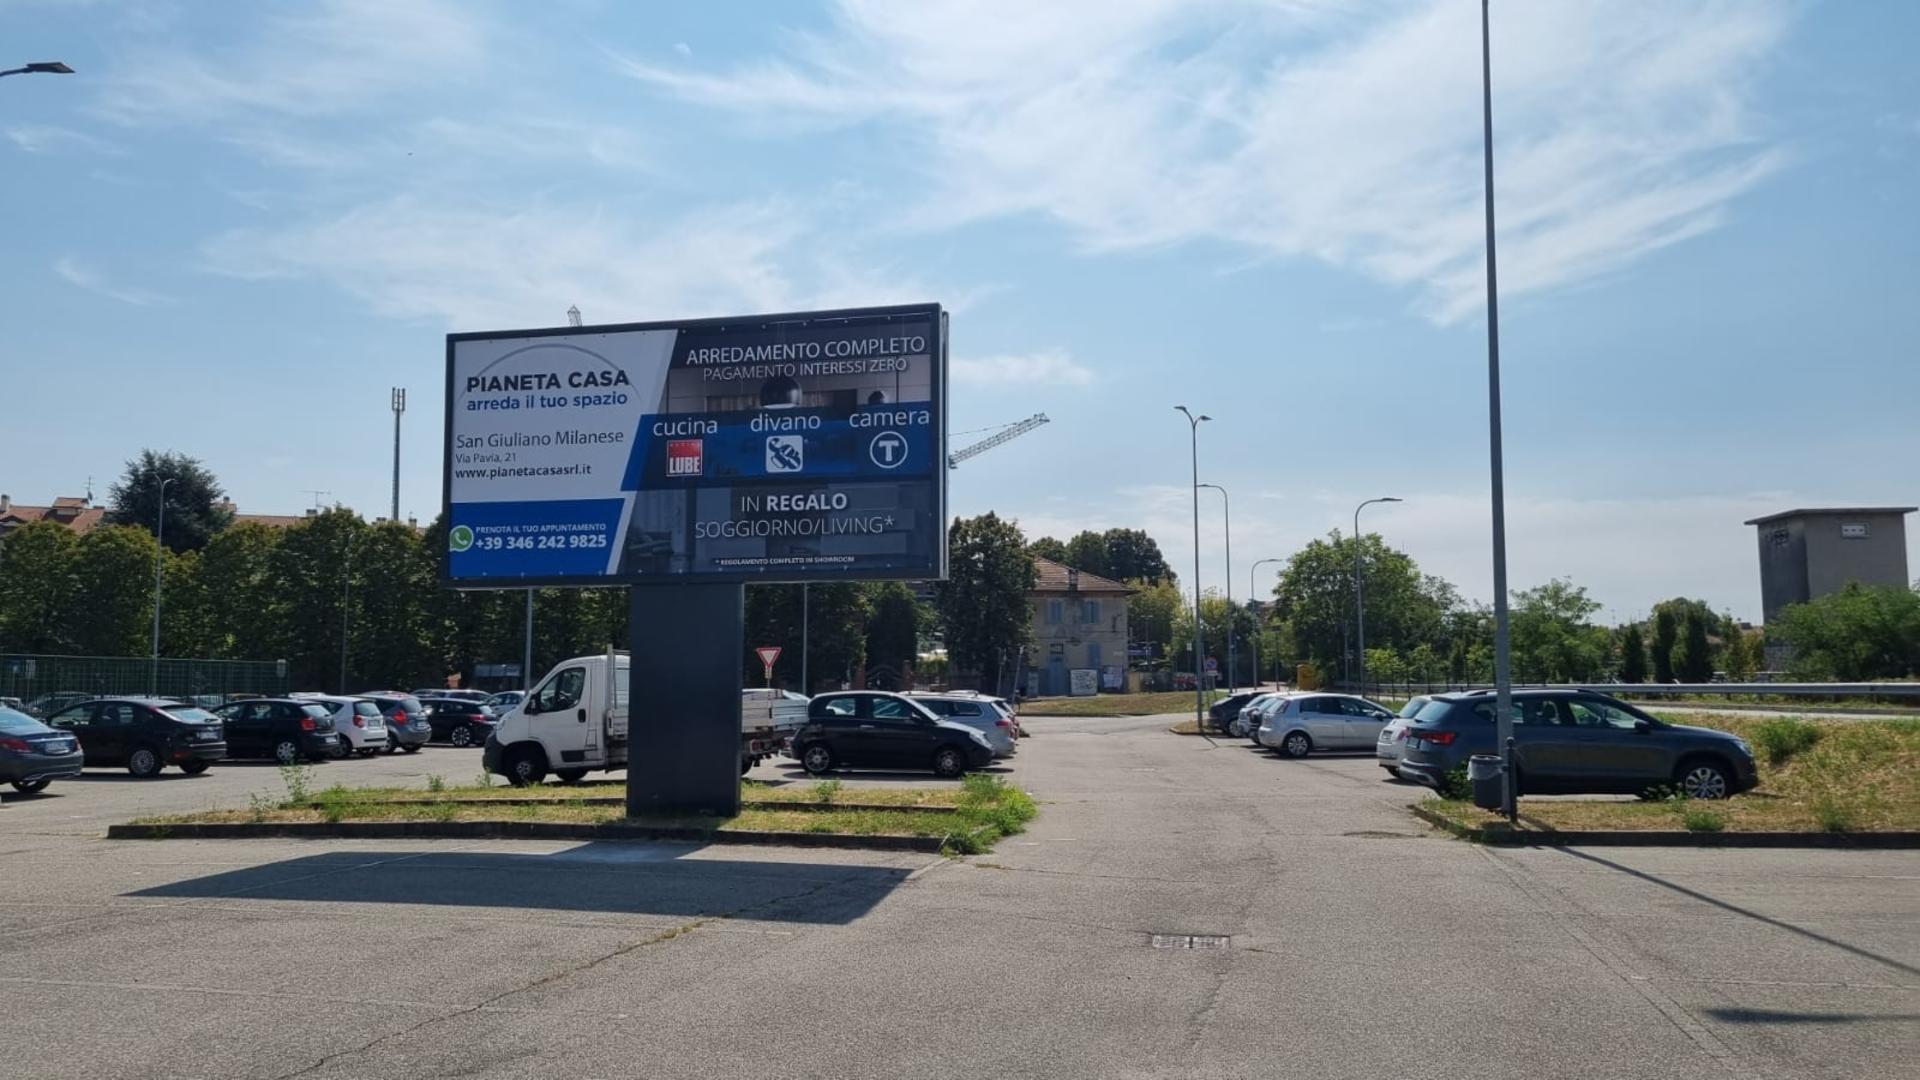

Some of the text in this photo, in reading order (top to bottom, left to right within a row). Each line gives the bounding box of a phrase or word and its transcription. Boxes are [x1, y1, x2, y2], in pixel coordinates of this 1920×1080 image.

[686, 335, 925, 365] ARREDAMENTO COMPLETO
[703, 357, 908, 381] PAGAMENTO INTERESSI ZERO
[466, 369, 630, 393] PIANETA CASA
[466, 391, 628, 411] arreda il tuo spazio
[653, 410, 930, 437] cucina divano camera
[456, 430, 624, 449] San Giuliano Milanese
[455, 452, 517, 464] Via Pavia, 21
[669, 456, 701, 474] LUBE
[455, 464, 592, 480] www.pianetacasasrl.it
[741, 493, 848, 512] IN REGALO
[475, 526, 511, 534] PRENOTA
[522, 525, 539, 533] TUO
[540, 523, 607, 532] APPUNTAMENTO
[475, 534, 607, 550] +39 346 242 9825
